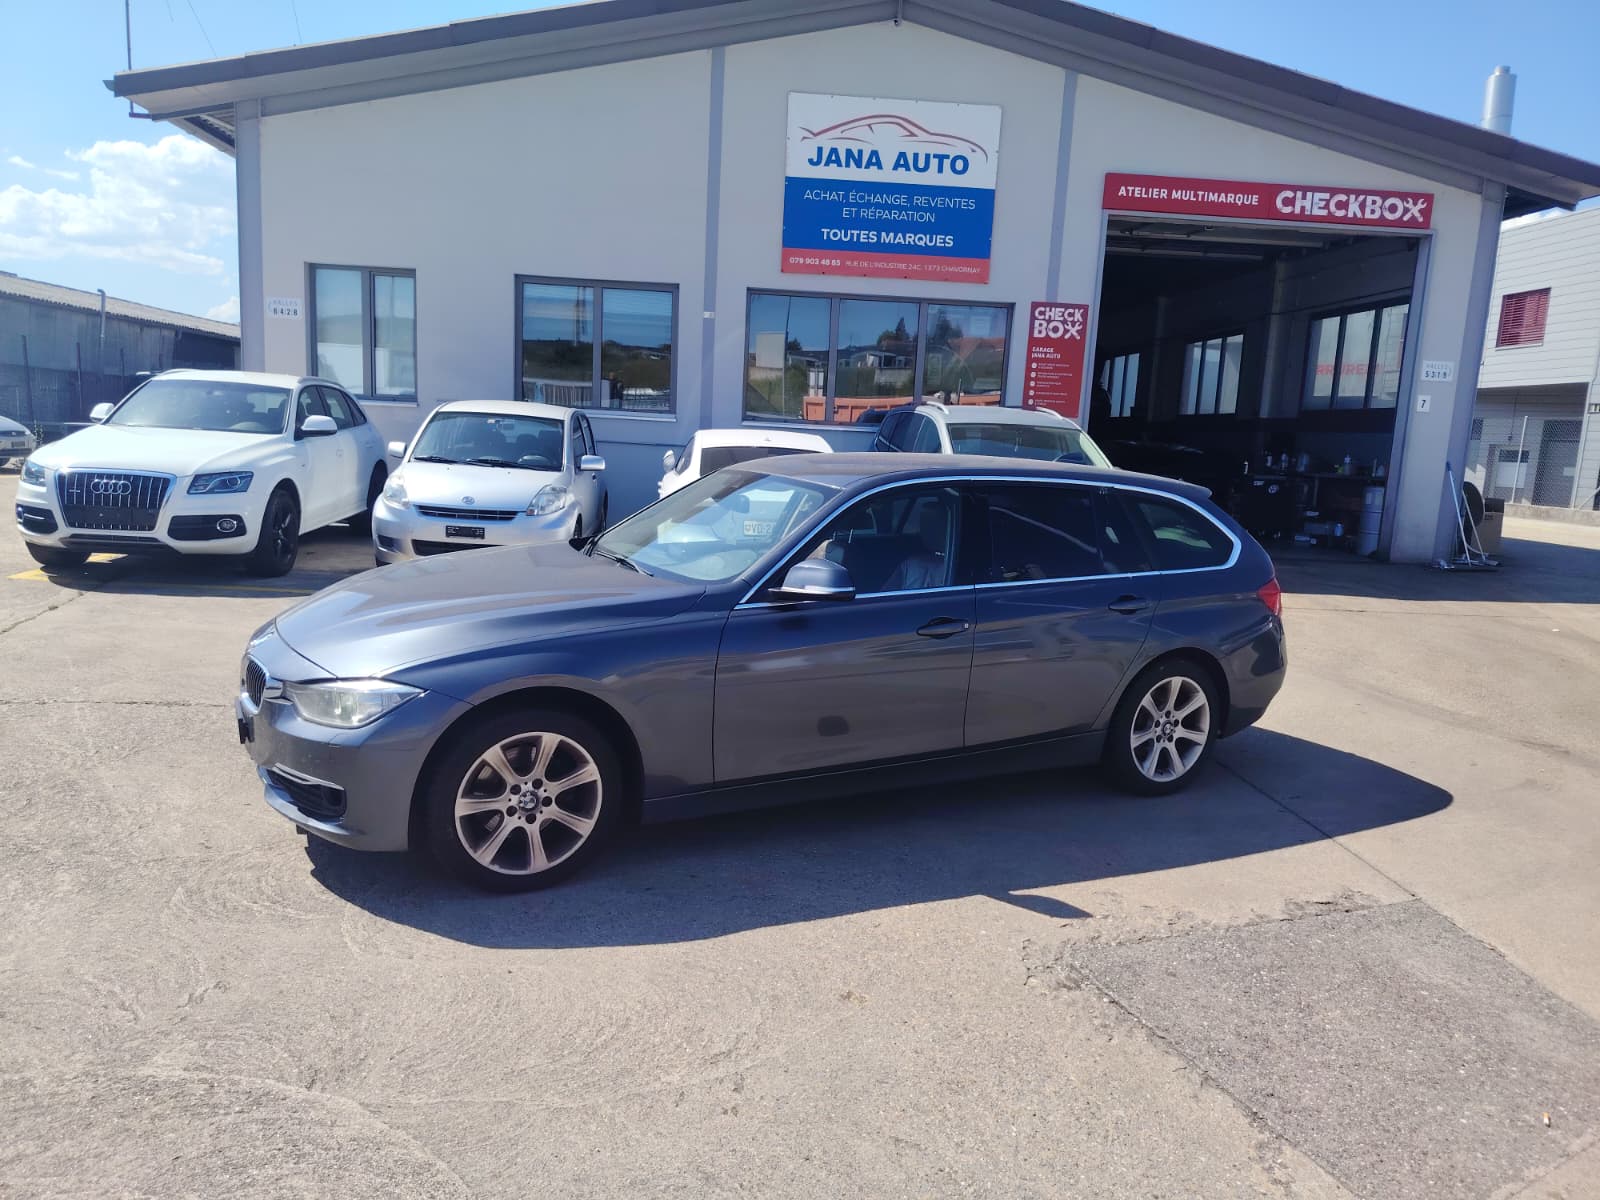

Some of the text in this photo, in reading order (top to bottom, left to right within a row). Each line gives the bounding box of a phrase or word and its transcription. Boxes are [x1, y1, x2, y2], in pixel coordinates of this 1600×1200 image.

[807, 146, 970, 176] JANA AUTO
[803, 189, 976, 210] ACHAT, ÉCHANGE, REVENTES
[1118, 185, 1259, 206] ATELIER MULTIMARQUE
[1275, 189, 1428, 223] CHECKBOX
[842, 206, 936, 223] ET RÉPARATION
[821, 228, 954, 248] TOUTES MARQUES
[1034, 306, 1085, 322] CHECK
[1033, 319, 1083, 340] BOX
[1421, 399, 1426, 409] 7
